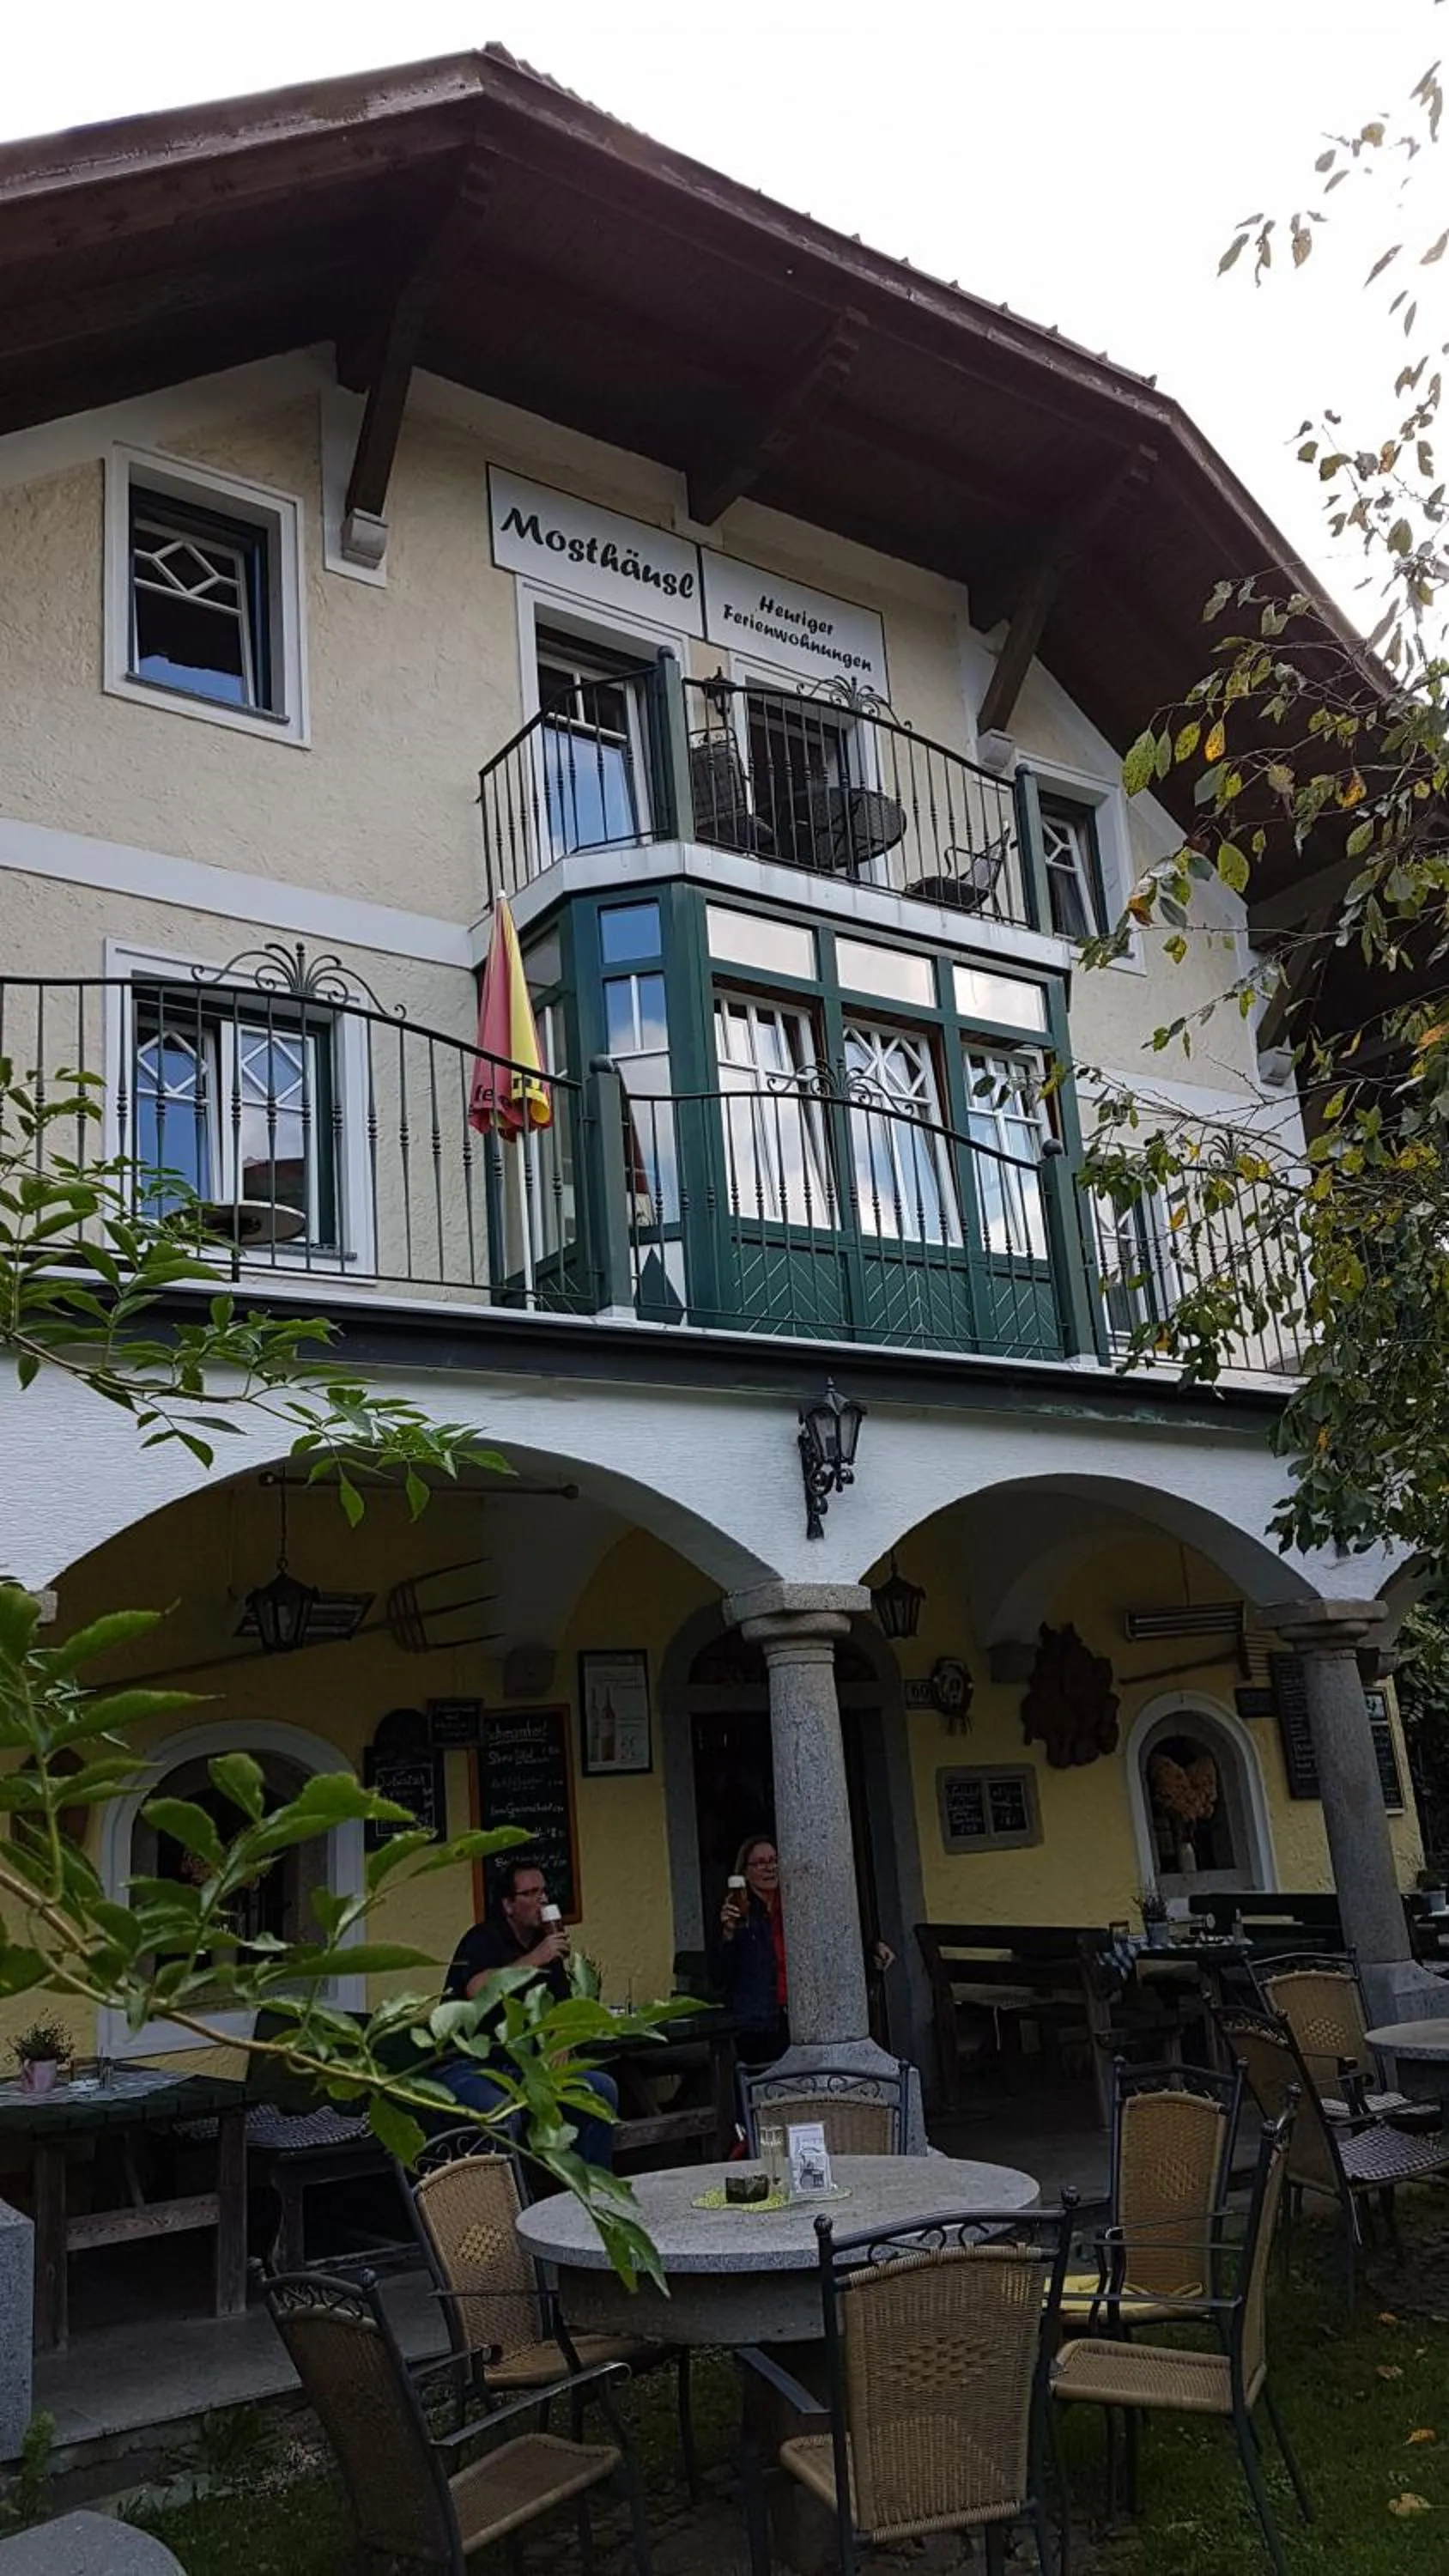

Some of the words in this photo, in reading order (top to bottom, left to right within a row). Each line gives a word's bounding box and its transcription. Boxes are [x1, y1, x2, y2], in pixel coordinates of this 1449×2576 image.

[500, 507, 694, 598] Mosthäusl
[724, 605, 871, 671] Ferienwohnungen
[759, 595, 834, 635] Heuriger
